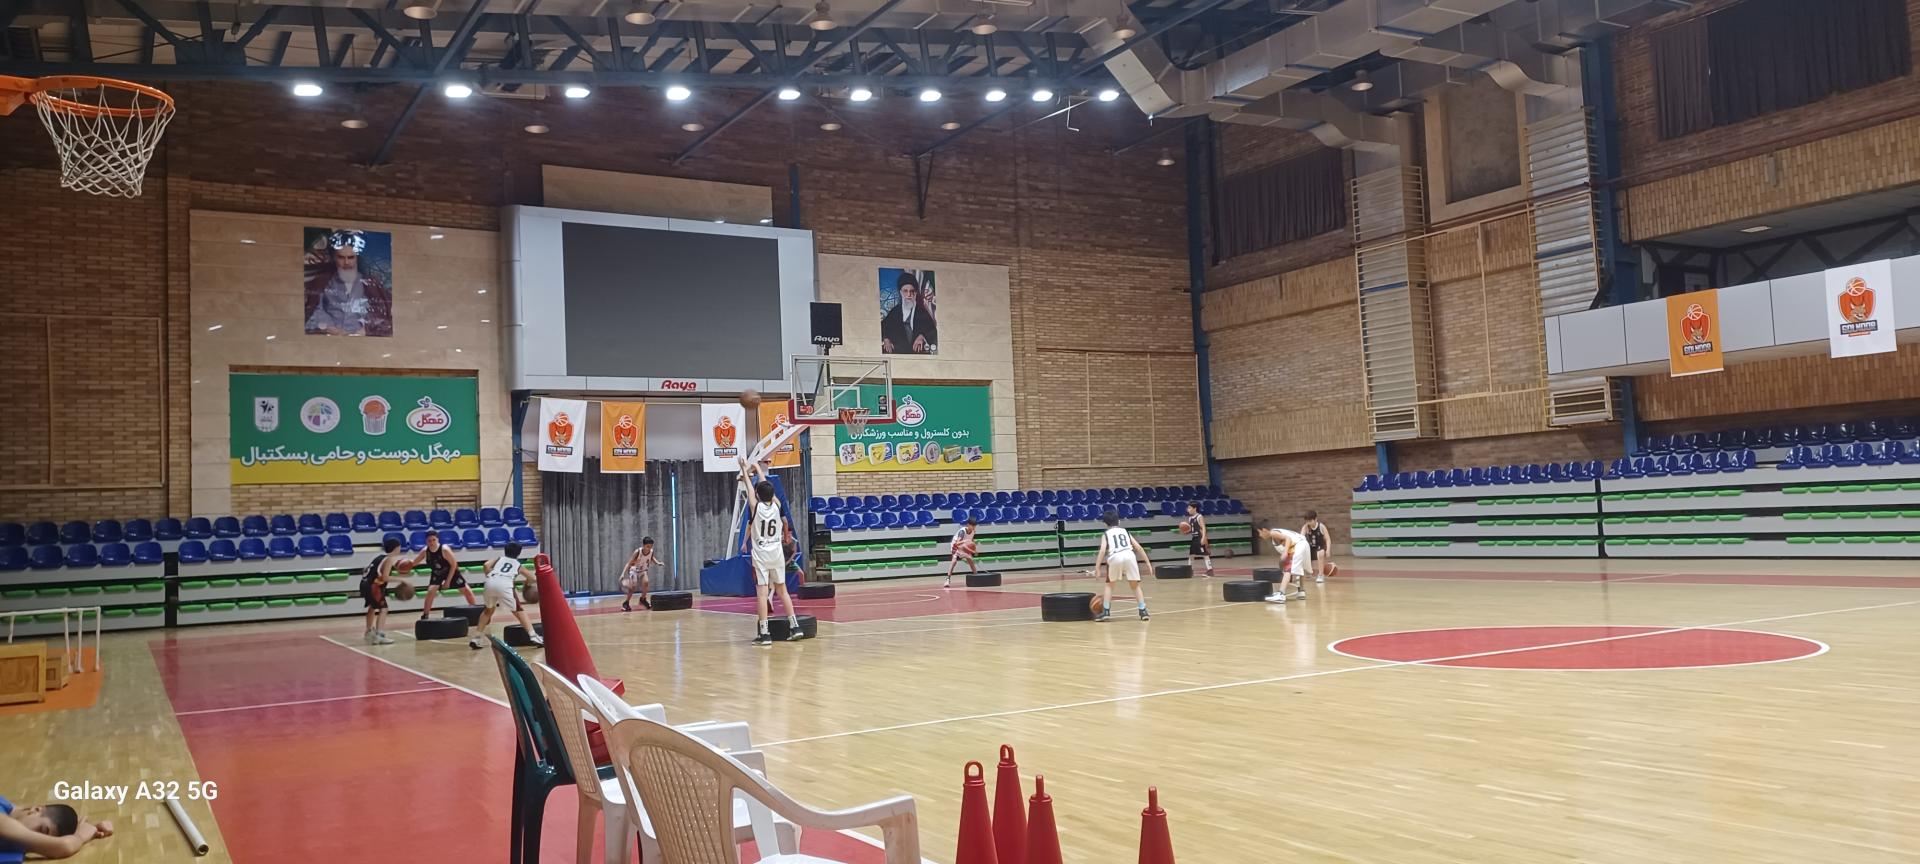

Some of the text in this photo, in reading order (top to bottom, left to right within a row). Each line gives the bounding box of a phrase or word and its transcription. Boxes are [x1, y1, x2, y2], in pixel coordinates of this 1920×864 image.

[814, 335, 840, 343] Raya
[661, 380, 697, 391] Raya
[888, 430, 913, 438] مناسب
[921, 429, 950, 439] کلسترول
[952, 430, 969, 438] بدون
[241, 442, 461, 465] مهگل دوست و حامی بسکتبال
[760, 519, 777, 537] 16
[1112, 533, 1128, 549] 18
[500, 562, 513, 573] 8
